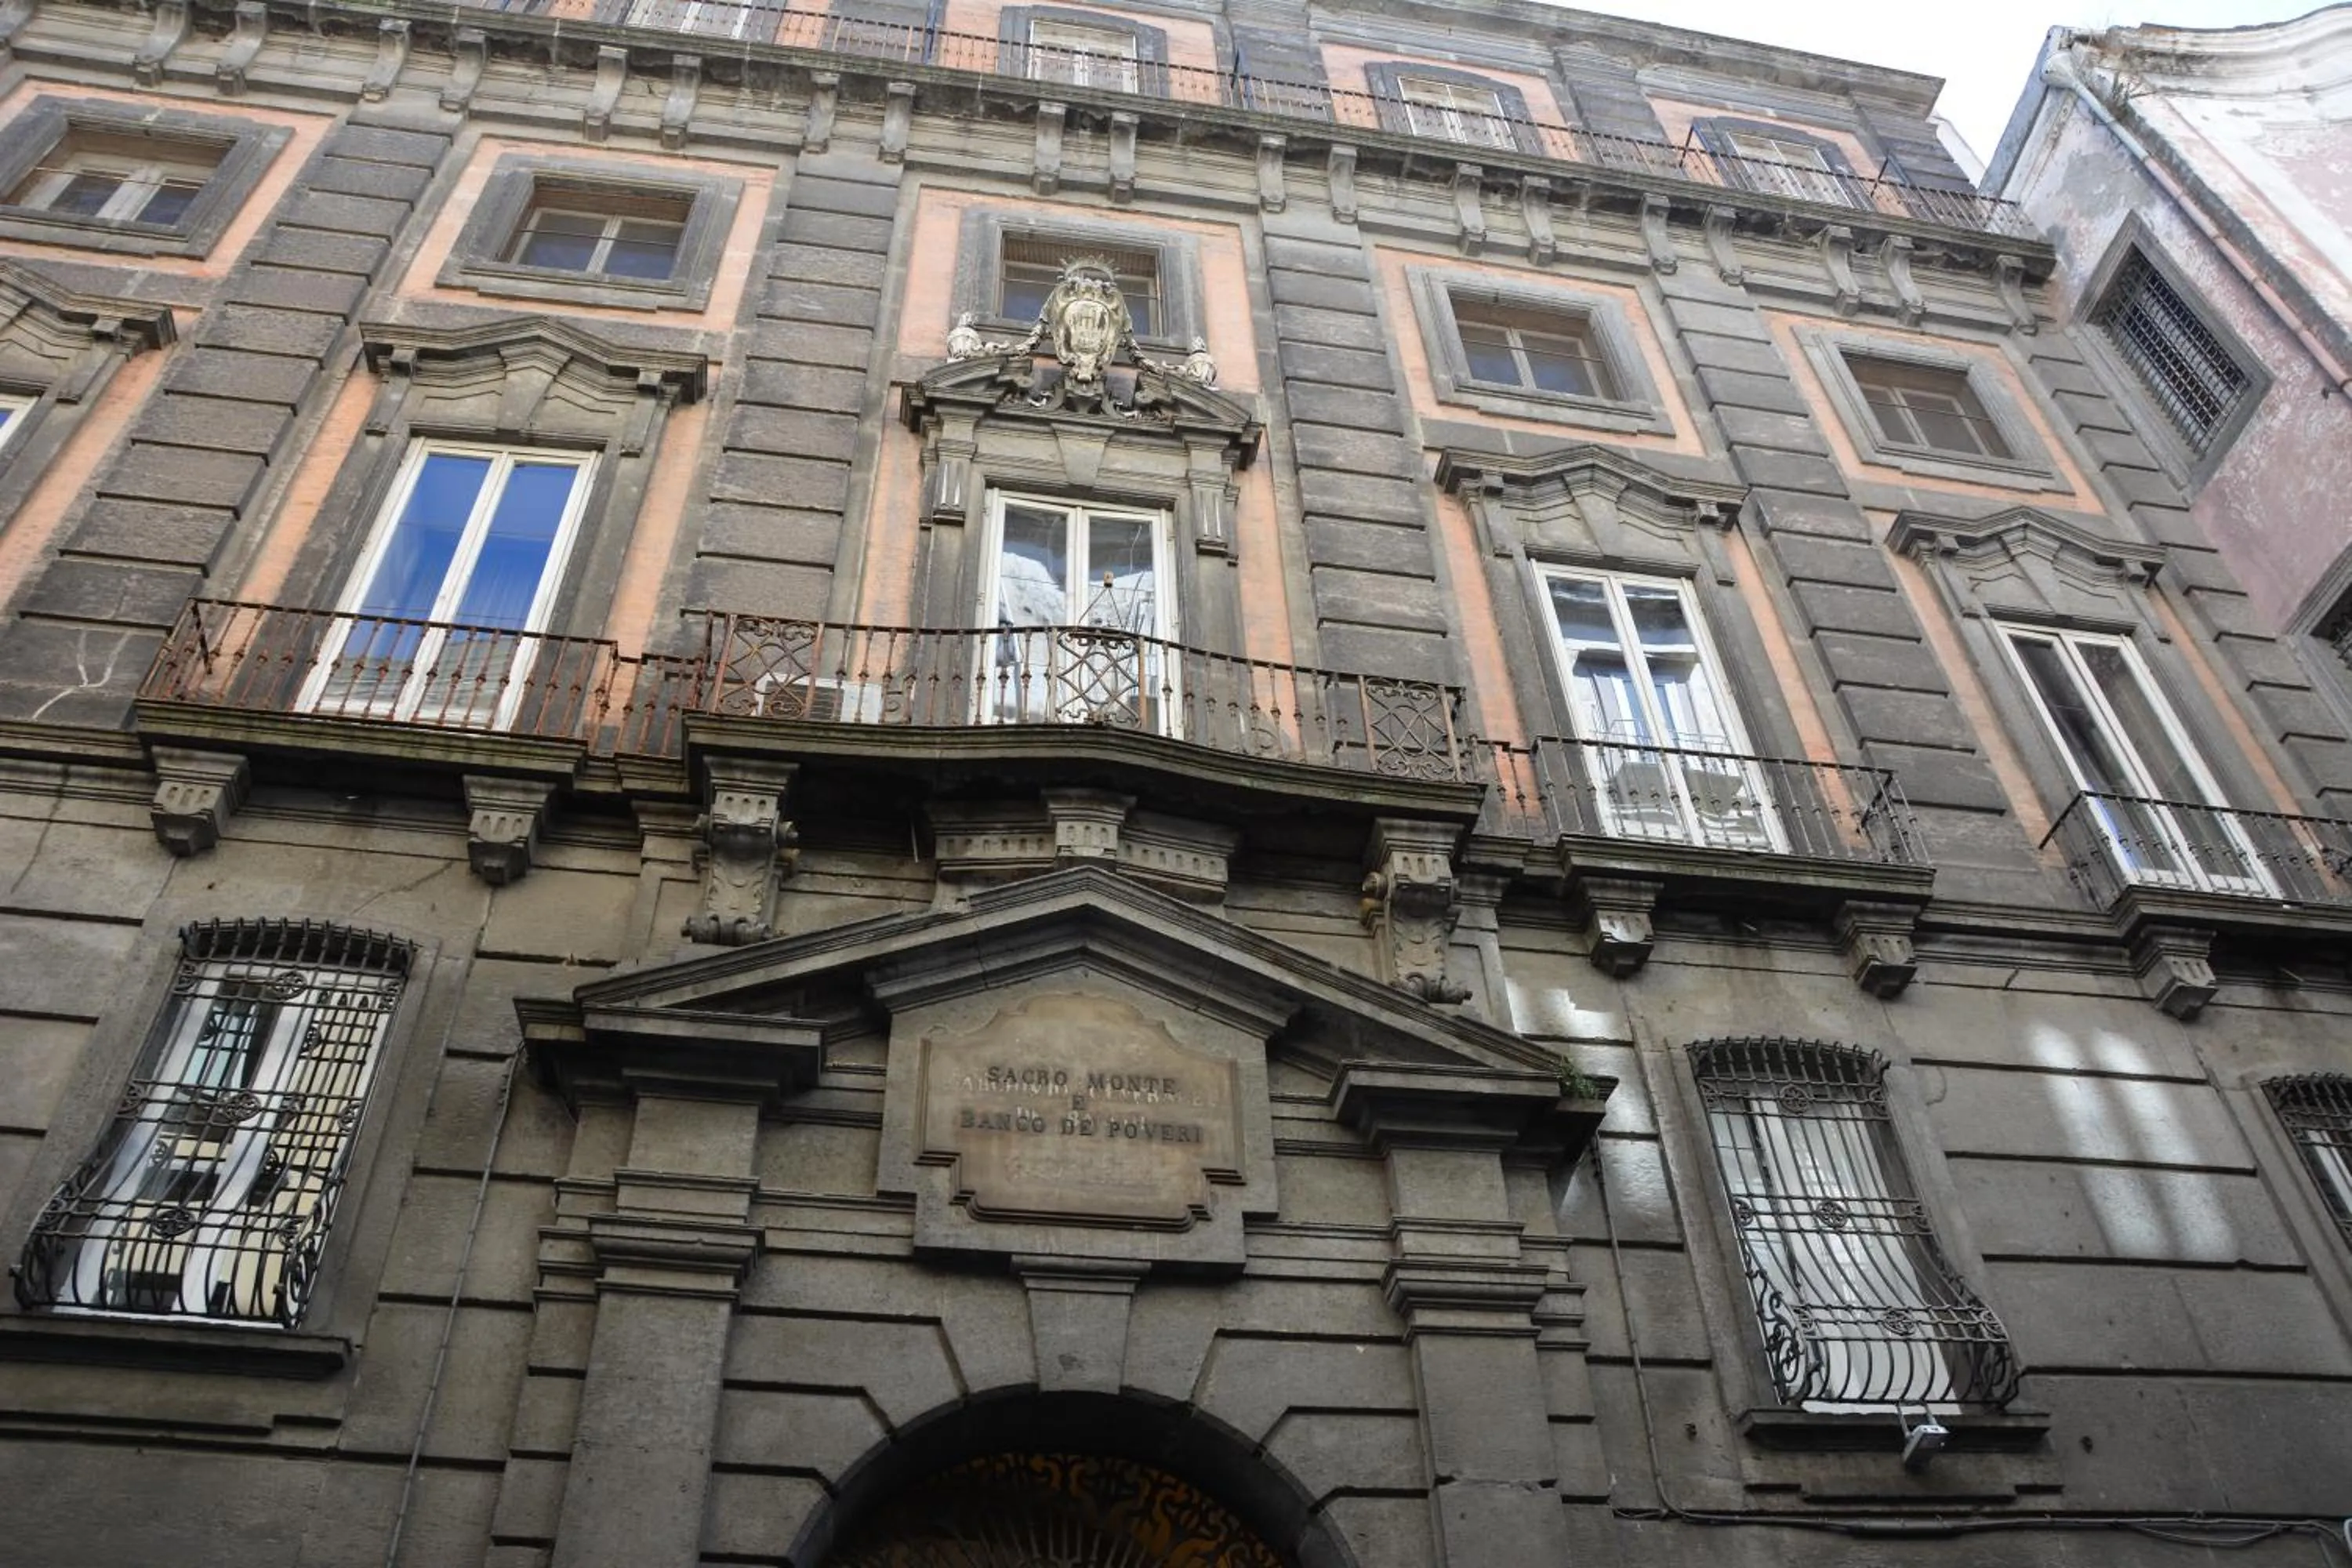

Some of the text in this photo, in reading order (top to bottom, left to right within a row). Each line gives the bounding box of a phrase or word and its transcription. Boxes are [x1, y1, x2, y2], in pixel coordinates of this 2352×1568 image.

[987, 1065, 1068, 1087] SACRO
[1087, 1073, 1177, 1094] MONTE
[1072, 1094, 1086, 1110] E
[960, 1109, 1047, 1134] BANCO
[1108, 1120, 1203, 1143] POVERI
